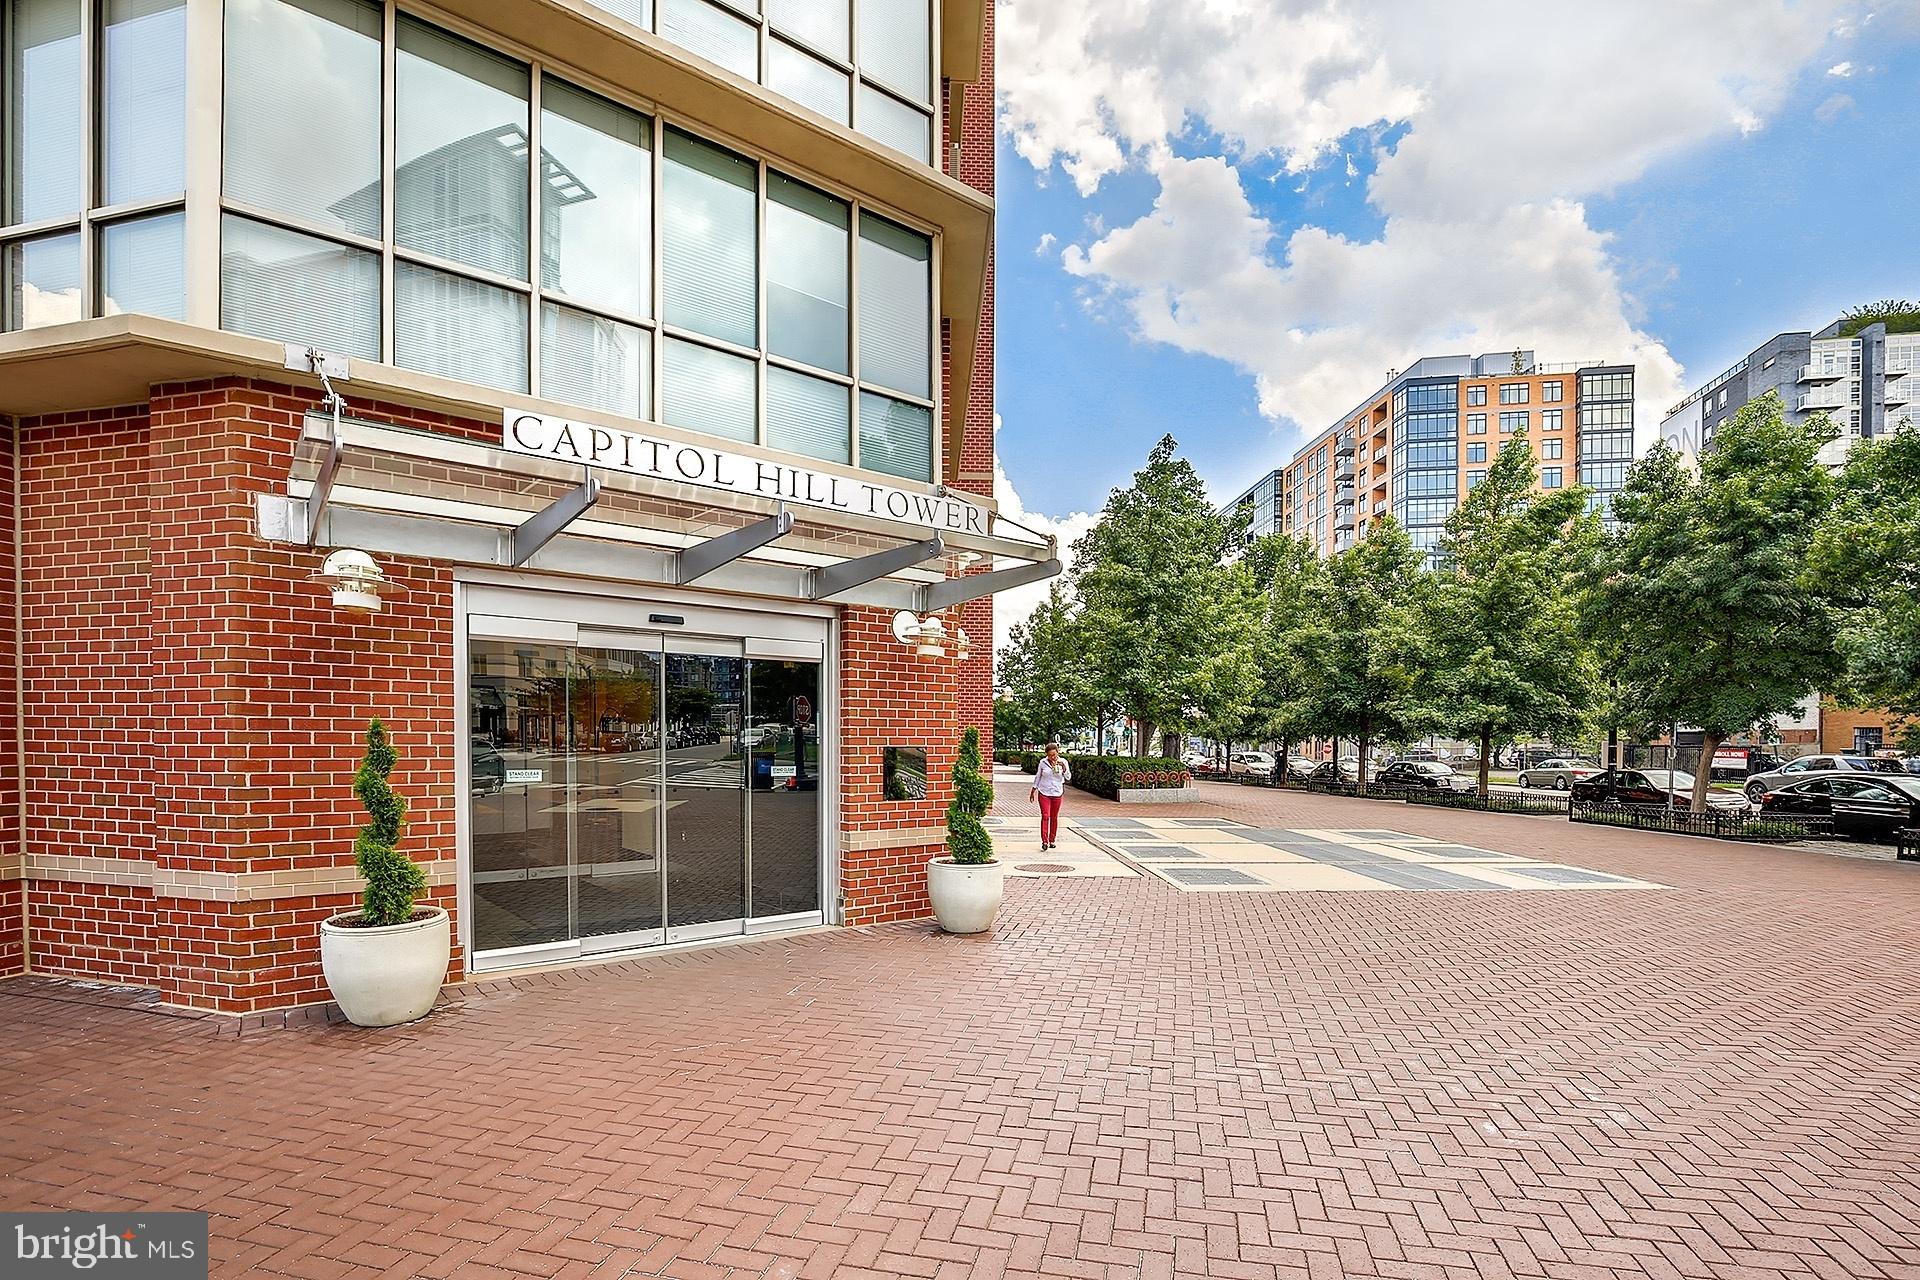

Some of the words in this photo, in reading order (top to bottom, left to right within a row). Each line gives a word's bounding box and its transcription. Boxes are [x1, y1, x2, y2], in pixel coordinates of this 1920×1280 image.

[512, 415, 735, 486] CAPITOL
[755, 462, 848, 507] HILL
[861, 484, 984, 534] TOWER
